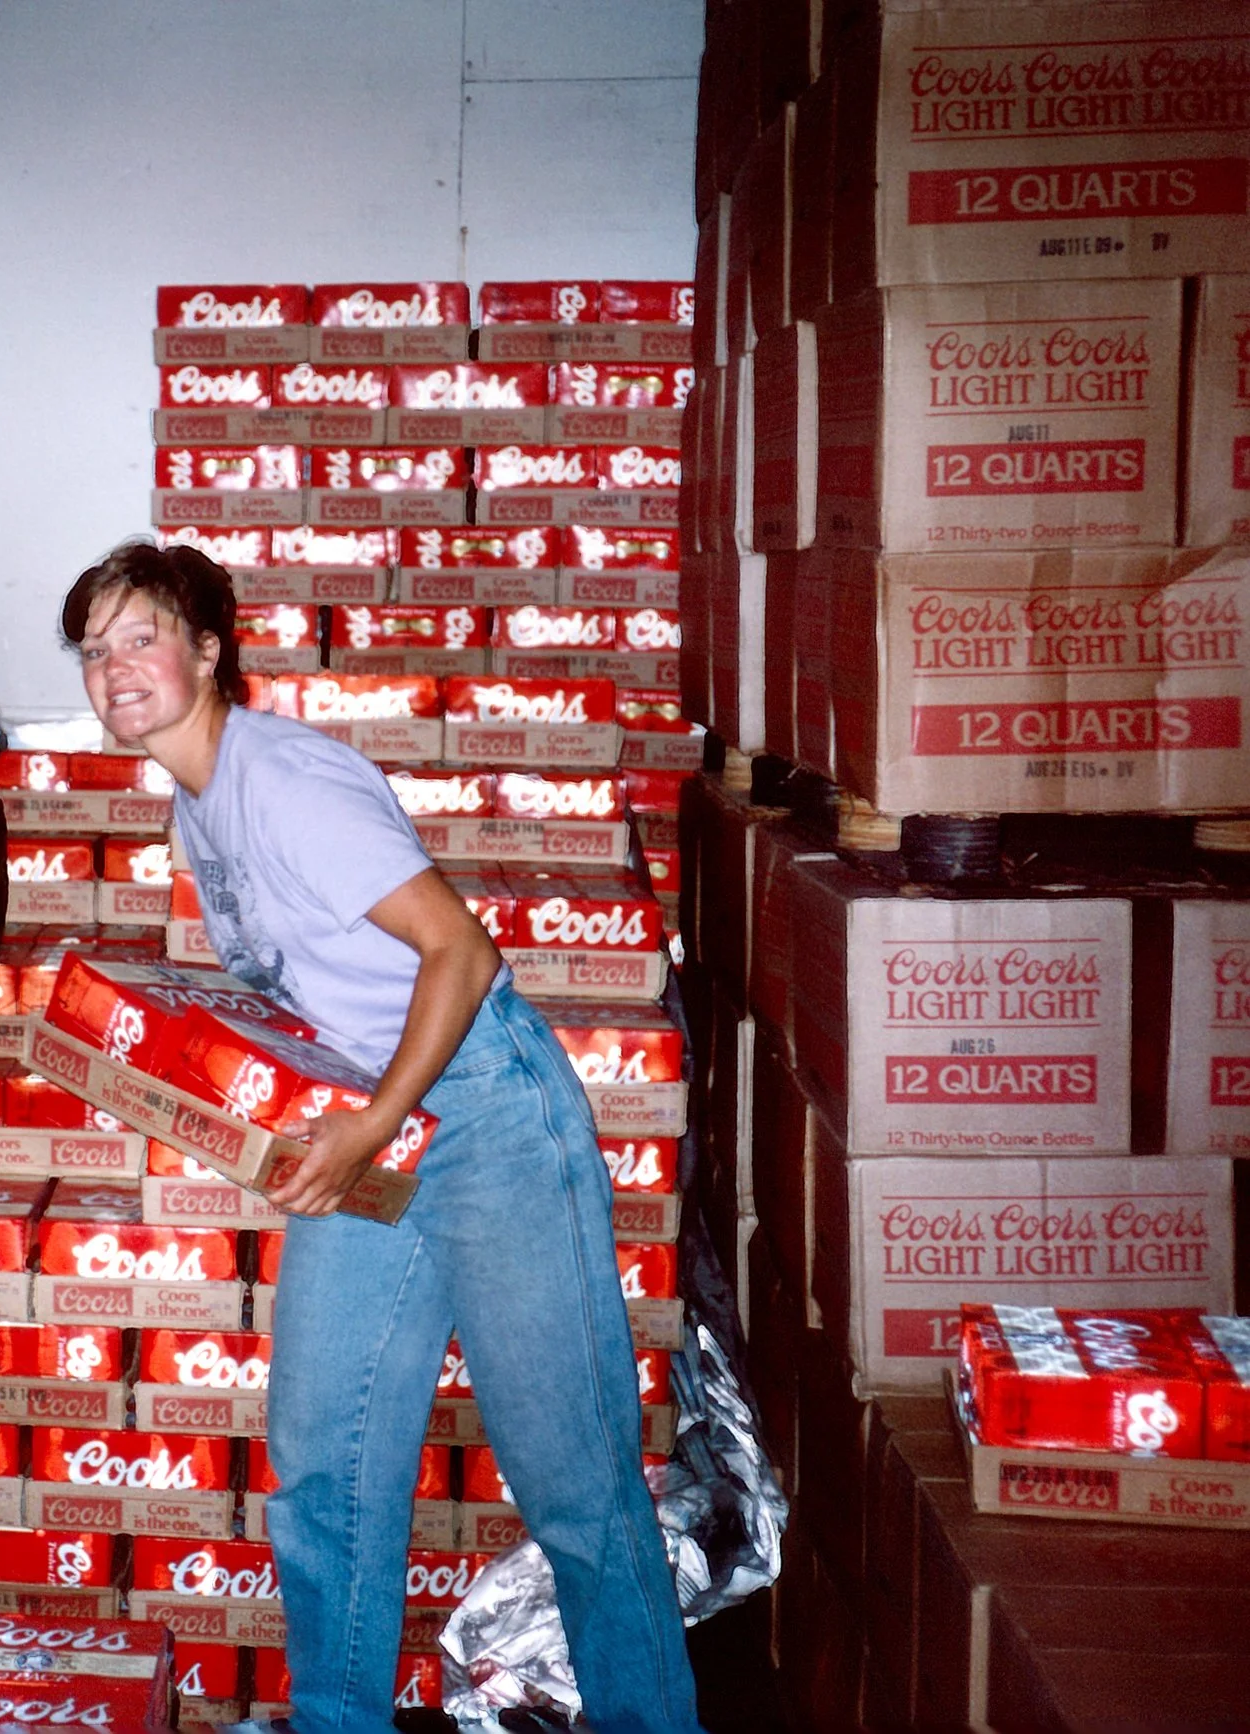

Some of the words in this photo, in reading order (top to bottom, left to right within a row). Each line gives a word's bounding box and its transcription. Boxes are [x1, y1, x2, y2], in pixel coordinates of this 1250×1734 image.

[910, 56, 1016, 97] Coors
[1022, 52, 1131, 96] Coors
[1141, 48, 1250, 87] Coors
[911, 99, 1019, 133] LIGHT
[1026, 95, 1135, 129] LIGHT
[1142, 92, 1250, 126] LIGHT
[955, 176, 999, 215] 12
[1010, 168, 1197, 212] QUARTS
[181, 292, 284, 327] Coors
[338, 289, 444, 328] Coors
[926, 331, 1033, 371] Coors
[1041, 328, 1149, 367] Coors
[168, 366, 262, 402] Coors
[282, 364, 376, 402] Coors
[416, 370, 524, 410] Coors
[929, 374, 1036, 407] LIGHT
[1045, 370, 1149, 405] LIGHT
[488, 446, 585, 485] Coors
[933, 455, 971, 487] 12
[981, 449, 1140, 485] QUARTS
[927, 527, 944, 541] 12
[950, 525, 1027, 541] Thirty-two
[1032, 523, 1083, 538] Ounce
[1086, 522, 1141, 537] Bottles
[313, 575, 372, 596] Coors
[411, 577, 473, 599] Coors
[575, 581, 635, 600] Coors
[507, 605, 602, 646] Coors
[910, 595, 1016, 634] Coors
[1022, 594, 1127, 631] Coors
[1132, 591, 1241, 628] Coors
[912, 637, 1016, 669] LIGHT
[1025, 633, 1129, 666] LIGHT
[1137, 629, 1242, 663] LIGHT
[474, 684, 587, 723] Coors
[372, 728, 408, 736] Coors
[547, 734, 583, 744] Coors
[958, 711, 1001, 747] 12
[1012, 705, 1191, 746] QUARTS
[462, 732, 524, 754] Coors
[501, 773, 614, 815] Coors
[550, 831, 612, 856] Coors
[19, 900, 27, 910] is
[28, 900, 45, 911] the
[47, 902, 72, 911] one.
[29, 890, 62, 900] Coors
[528, 897, 648, 946] Coors
[572, 960, 642, 984] Coors
[882, 948, 990, 986] Coors
[994, 946, 1101, 986] Coors
[887, 991, 989, 1020] LIGHT
[999, 989, 1100, 1019] LIGHT
[35, 1035, 87, 1084] Coors
[891, 1065, 928, 1094] 12
[938, 1063, 1092, 1095] QUARTS
[101, 1082, 114, 1100] is
[113, 1088, 134, 1113] the
[134, 1102, 158, 1125] one.
[599, 1092, 645, 1106] Coors
[173, 1107, 243, 1163] Coors
[887, 1132, 905, 1145] 12
[911, 1131, 985, 1148] Thirty-two
[989, 1131, 1038, 1146] Ounce
[1042, 1131, 1094, 1146] Bottles
[6, 1151, 34, 1163] one.
[53, 1141, 124, 1166] Coors
[163, 1187, 240, 1214] Coors
[253, 1199, 264, 1215] is
[879, 1204, 985, 1242] Coors
[992, 1203, 1097, 1241] Coors
[1103, 1202, 1208, 1240] Coors
[72, 1233, 206, 1281] Coors
[884, 1247, 985, 1275] LIGHT
[995, 1245, 1097, 1275] LIGHT
[1107, 1243, 1209, 1273] LIGHT
[56, 1287, 132, 1314] Coors
[145, 1302, 156, 1317] is
[159, 1303, 183, 1318] the
[185, 1305, 214, 1319] one.
[158, 1289, 201, 1303] Coors
[31, 1391, 105, 1416] Coors
[155, 1399, 228, 1425] Coors
[64, 1441, 197, 1489] Coors
[1170, 1477, 1234, 1496] Coors
[45, 1499, 119, 1525] Coors
[133, 1515, 146, 1529] is
[147, 1515, 170, 1530] the
[172, 1517, 201, 1532] one.
[147, 1503, 191, 1516] Coors
[151, 1607, 223, 1635] Coors
[237, 1623, 249, 1636] is
[252, 1624, 275, 1638] the
[18, 1673, 74, 1683] PACK
